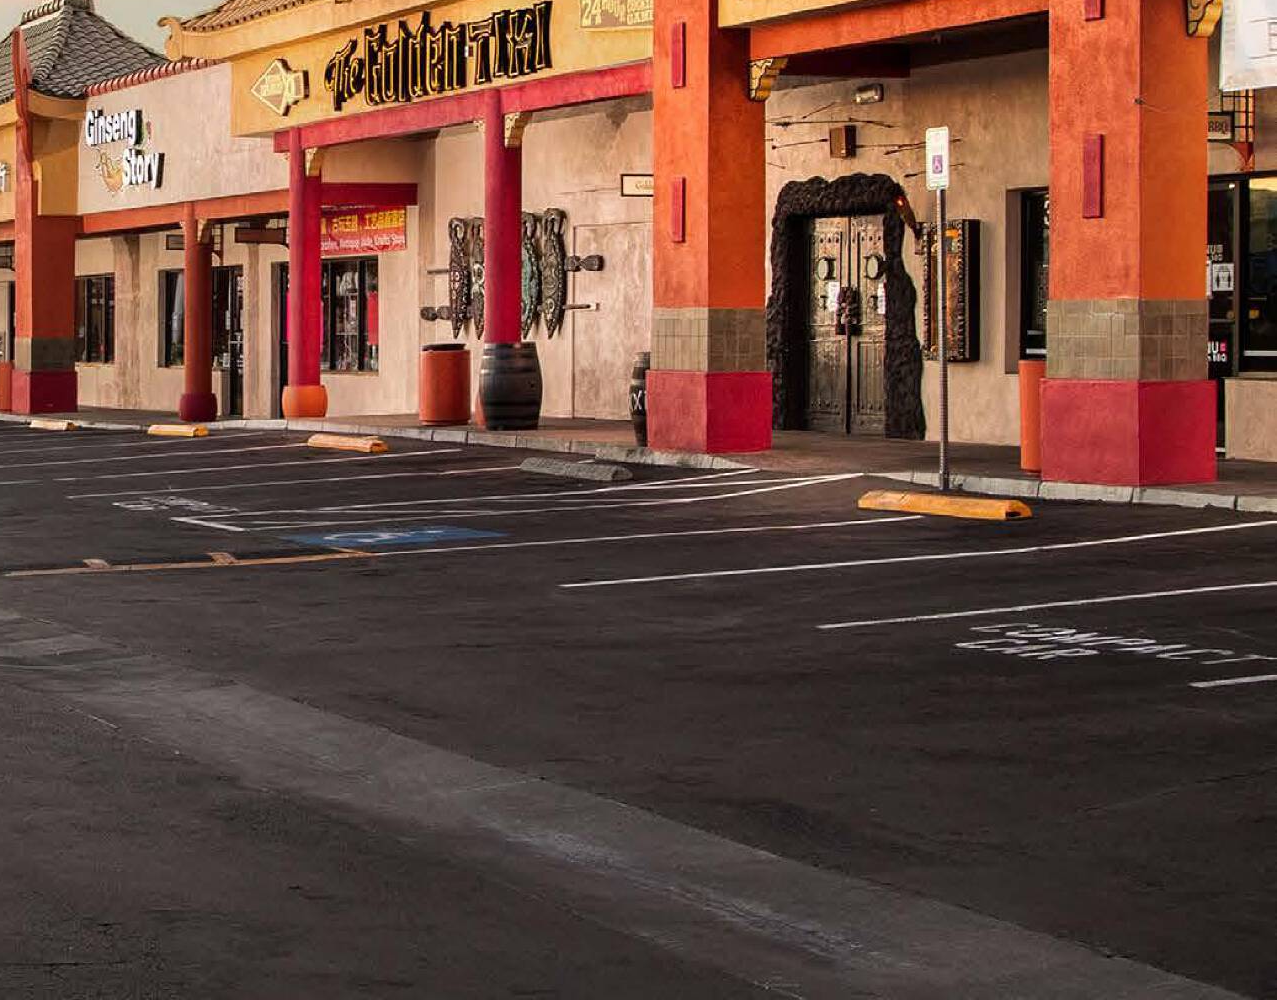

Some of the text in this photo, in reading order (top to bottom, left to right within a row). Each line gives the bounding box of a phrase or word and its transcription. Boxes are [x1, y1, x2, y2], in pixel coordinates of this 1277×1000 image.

[324, 38, 365, 111] The
[364, 11, 468, 107] Golden
[85, 109, 140, 147] Ginseng
[122, 147, 164, 190] Story
